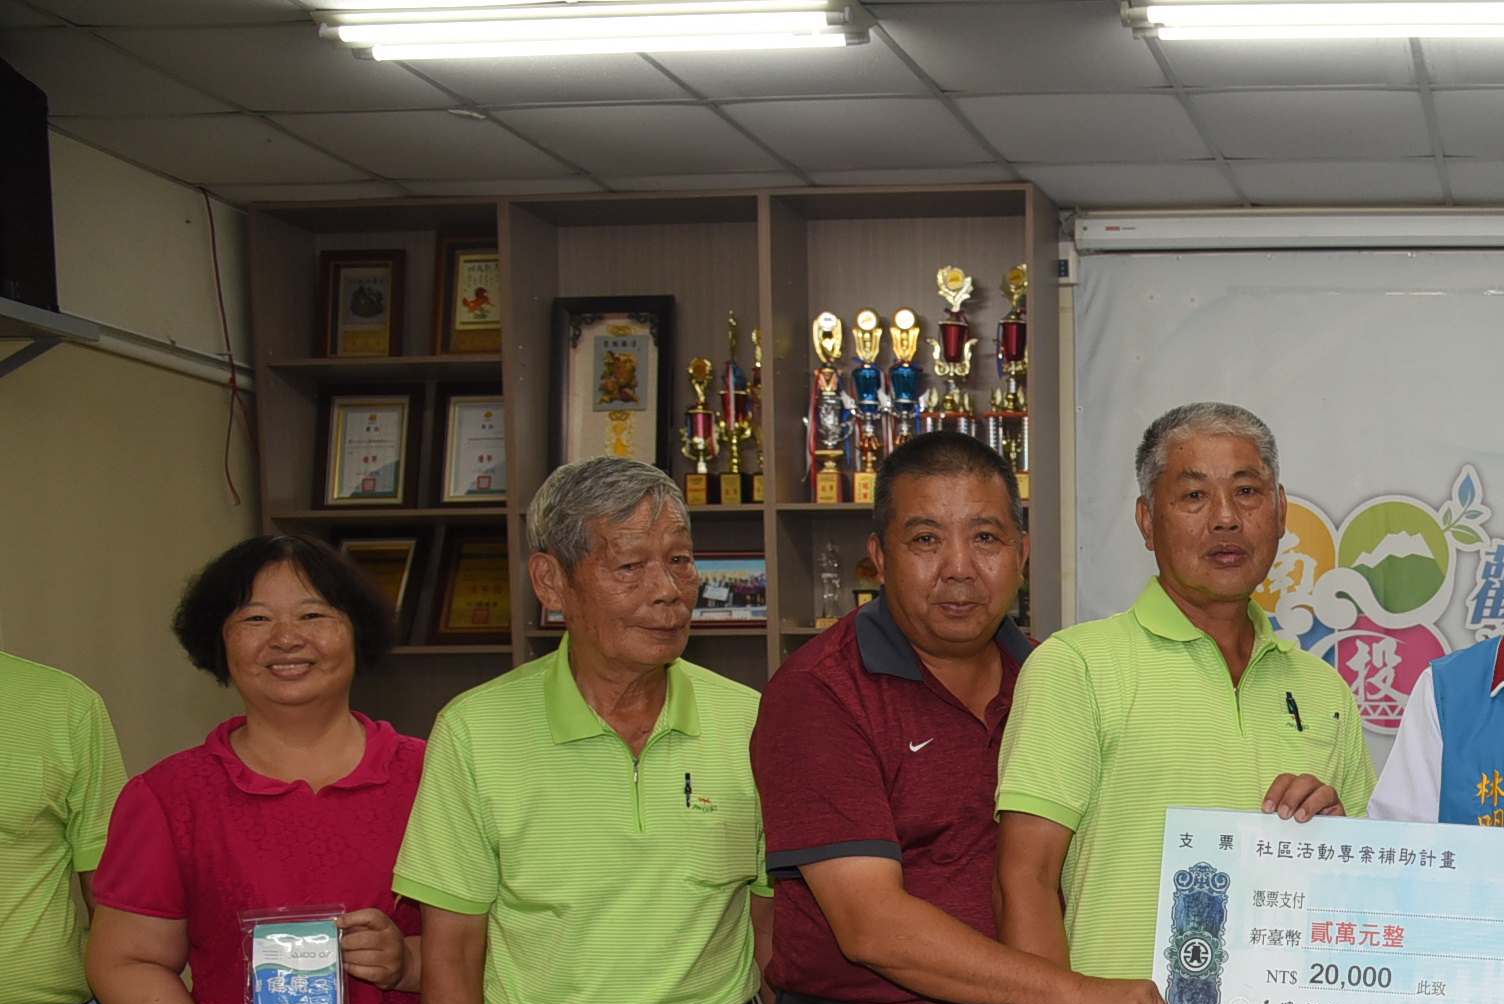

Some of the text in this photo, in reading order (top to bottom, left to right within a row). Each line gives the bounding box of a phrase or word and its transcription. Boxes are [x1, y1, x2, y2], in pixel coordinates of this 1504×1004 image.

[1178, 832, 1458, 870] 支票 社區活動專案補助計畫
[1252, 890, 1306, 910] 憑票支付
[1249, 921, 1405, 948] 新臺幣 貳萬元整
[1266, 963, 1446, 996] NT$ 20,000 此致
